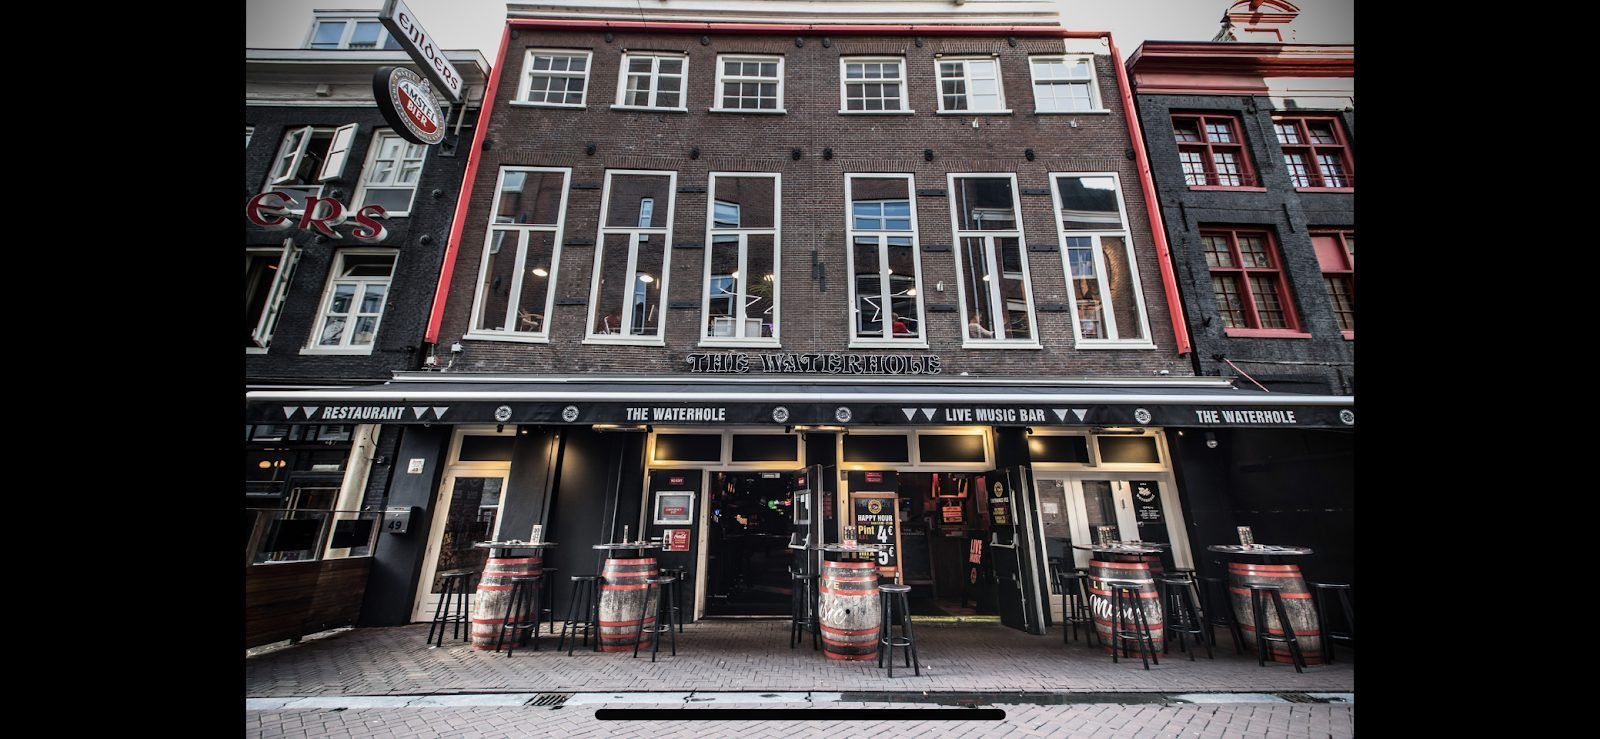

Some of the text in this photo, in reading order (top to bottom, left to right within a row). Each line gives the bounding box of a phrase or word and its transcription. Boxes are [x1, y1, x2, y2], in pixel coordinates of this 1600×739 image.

[402, 83, 436, 122] AMSTEL
[407, 100, 428, 127] BIER
[687, 353, 942, 375] THE WATERHOLE
[322, 406, 405, 420] RESTAURANT
[626, 407, 726, 421] THE WATERHOLE
[945, 408, 1046, 422] LIVE MUSIC BAR
[1196, 410, 1297, 424] THE WATERHOLE
[388, 520, 402, 530] 49
[857, 514, 893, 522] HAPPY HOUR
[857, 525, 875, 535] Pint
[970, 538, 983, 554] LIVE
